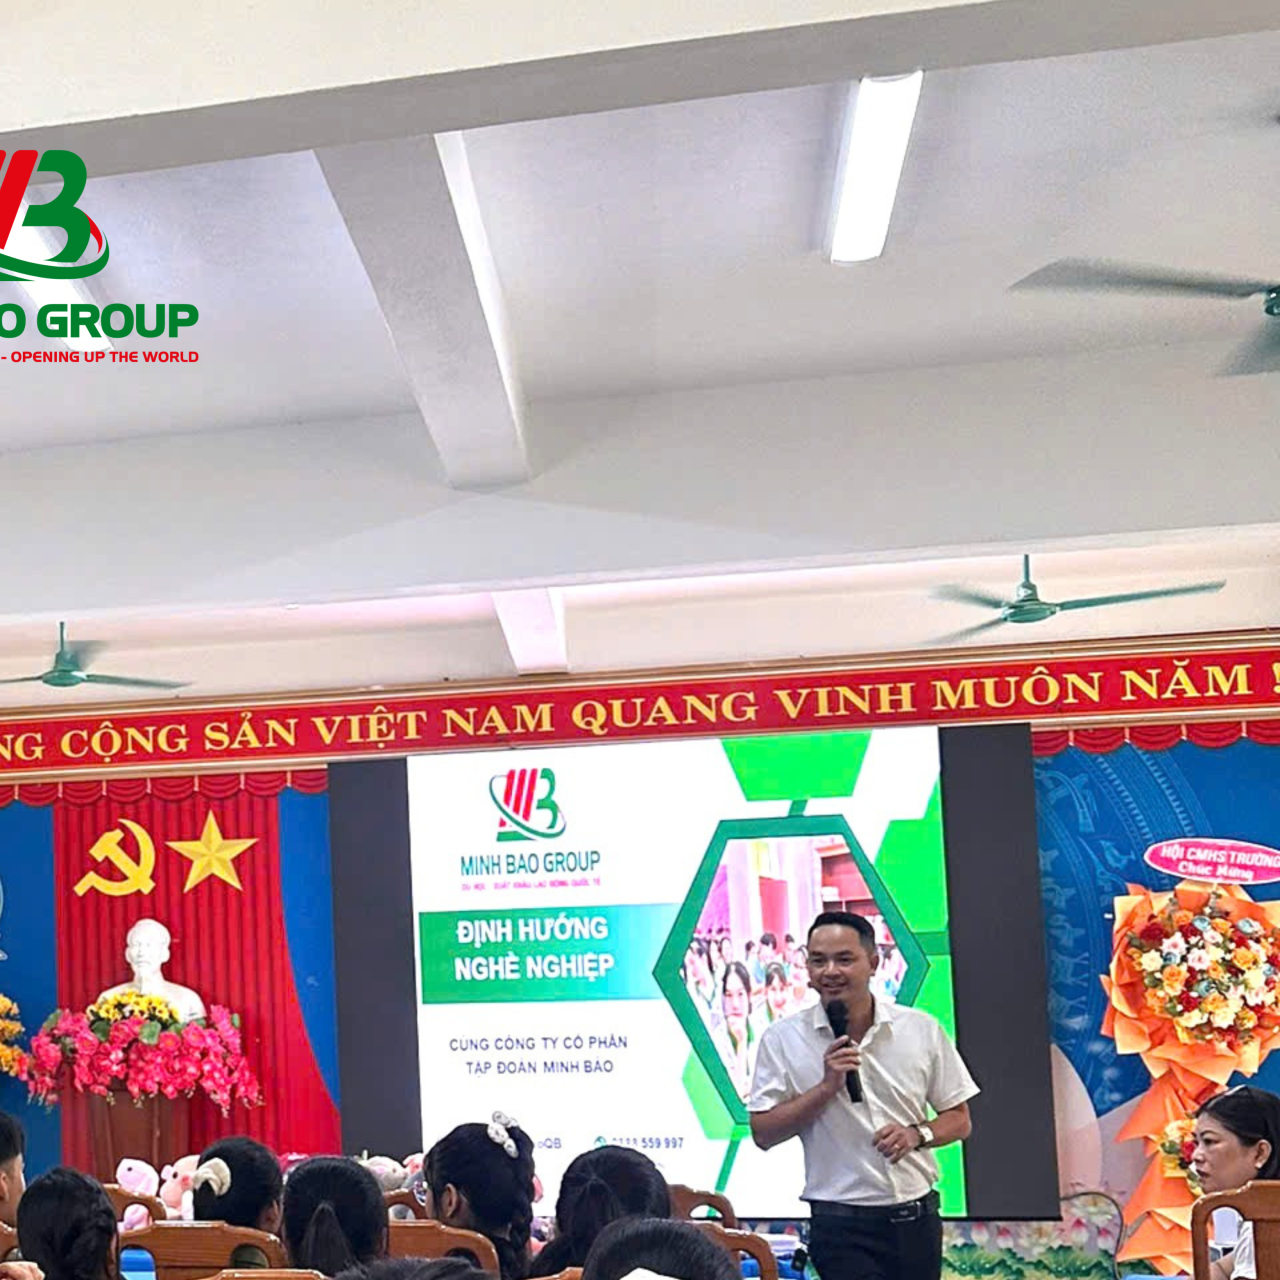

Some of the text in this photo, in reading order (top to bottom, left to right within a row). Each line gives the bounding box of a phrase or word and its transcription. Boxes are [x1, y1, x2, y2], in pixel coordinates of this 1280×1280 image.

[60, 720, 190, 763] CỘNG
[204, 711, 298, 751] SẢN
[311, 705, 427, 749] VIỆT
[442, 703, 555, 738] NAM
[571, 690, 759, 736] QUANG
[773, 682, 917, 719] VINH
[931, 665, 1103, 711] MUÔN
[1120, 658, 1254, 700] NĂM
[460, 850, 601, 876] MINH BAO GROUP
[1186, 847, 1226, 862] CMHS
[456, 912, 609, 948] ĐỊNH HƯỚNG
[525, 952, 615, 982] NGHIỆP
[541, 1037, 559, 1049] TY
[543, 1060, 580, 1073] MINH
